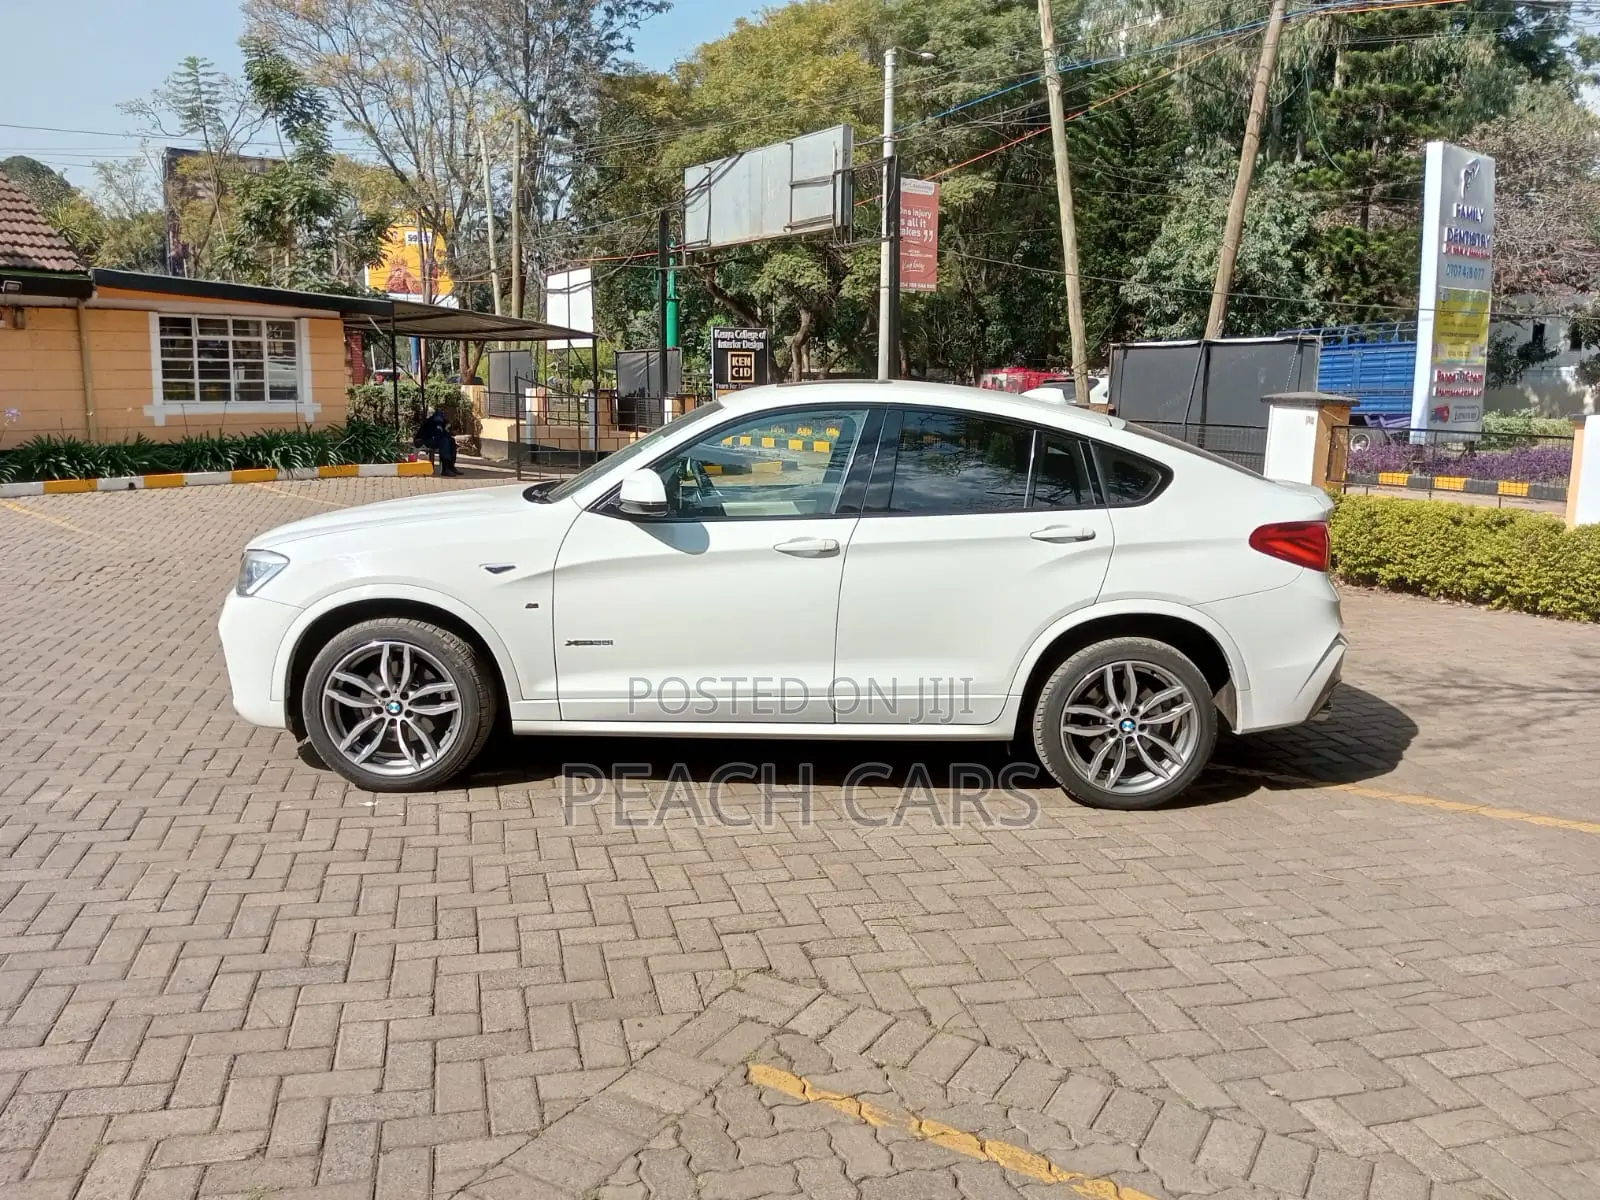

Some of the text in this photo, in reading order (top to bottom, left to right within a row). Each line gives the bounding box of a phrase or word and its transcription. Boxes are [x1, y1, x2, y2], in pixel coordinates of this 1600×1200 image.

[913, 208, 932, 219] injury
[1453, 203, 1484, 224] FAMILY
[907, 217, 918, 227] all
[920, 219, 926, 229] it
[900, 227, 921, 237] akes
[1445, 227, 1490, 248] DENTISTRY
[715, 329, 766, 341] Kenya College of
[718, 339, 764, 351] Interior Design
[732, 356, 751, 366] KEN
[732, 367, 751, 377] CID
